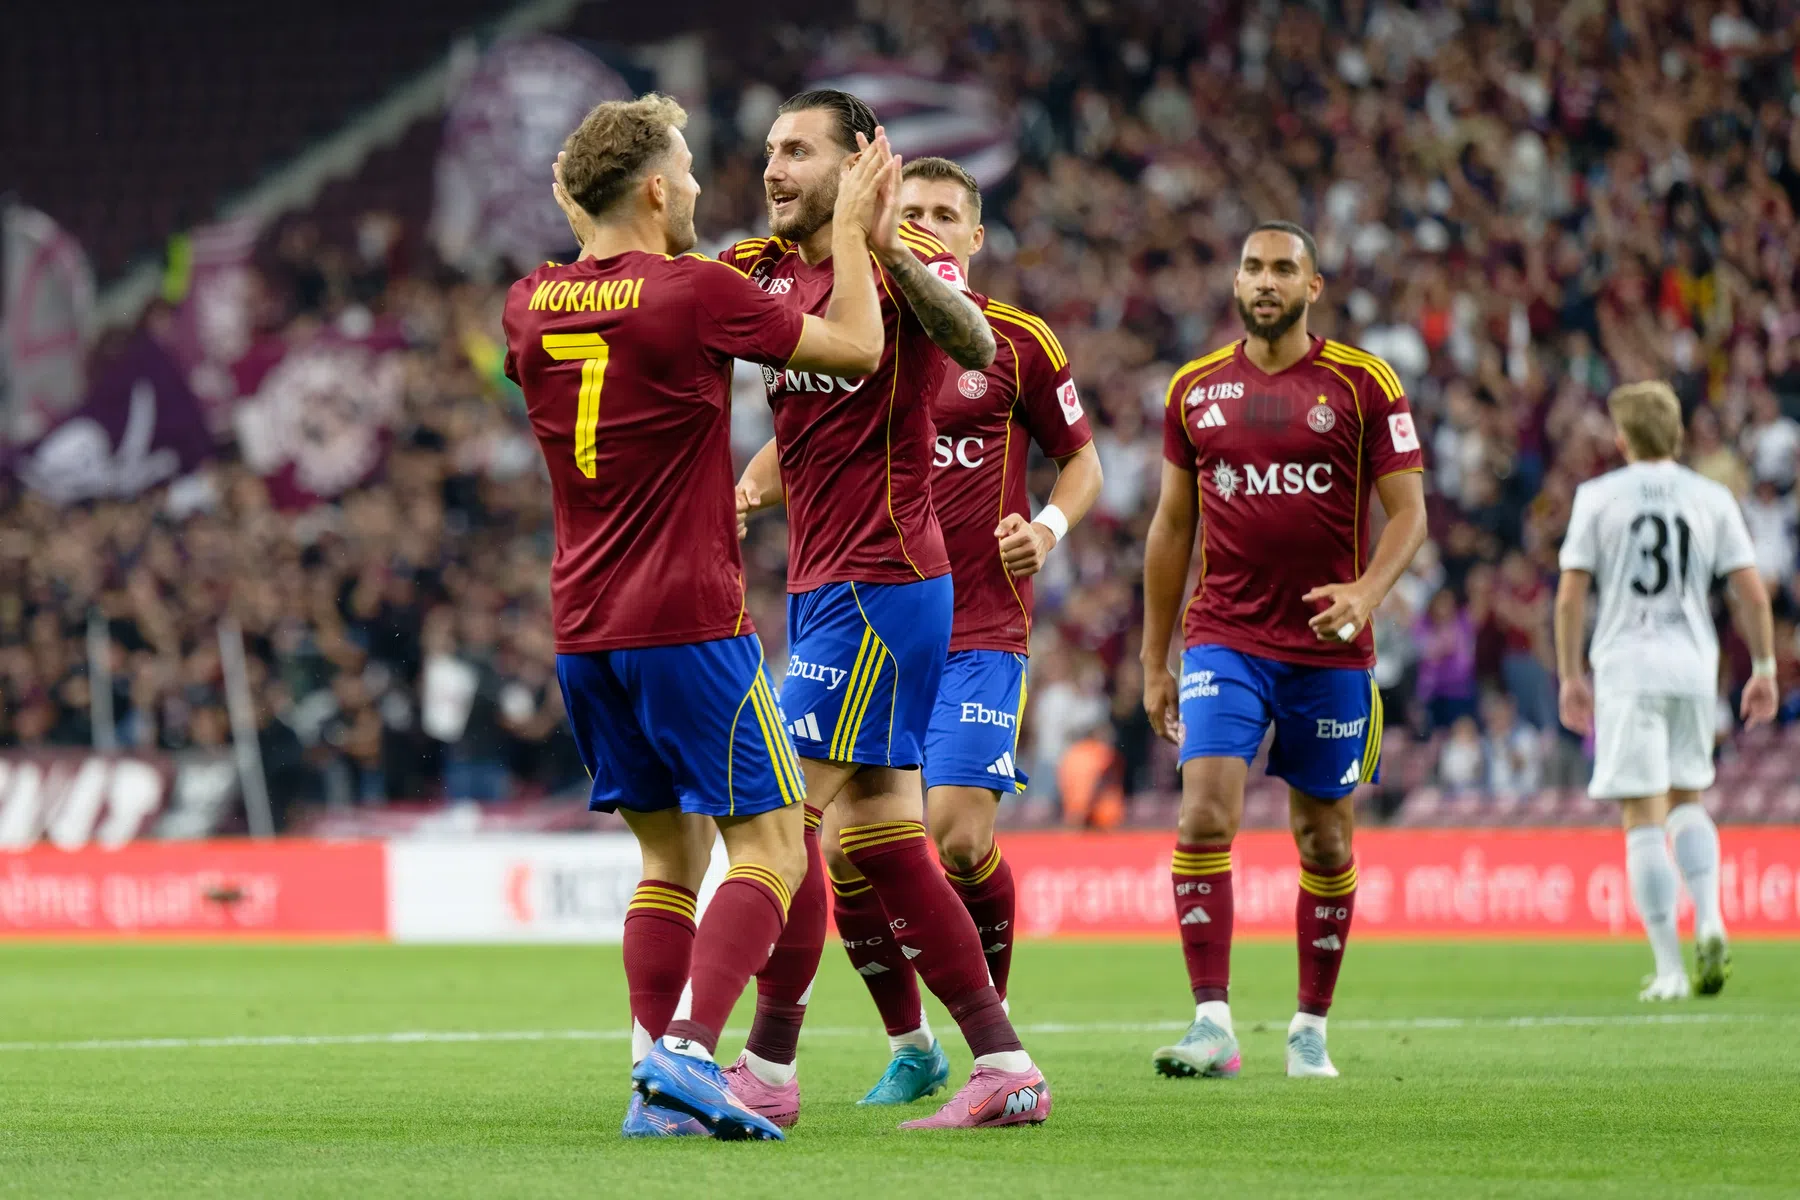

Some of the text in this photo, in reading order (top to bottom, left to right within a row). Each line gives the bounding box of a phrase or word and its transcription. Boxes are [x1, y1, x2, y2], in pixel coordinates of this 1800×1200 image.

[528, 277, 645, 312] MORANDI
[541, 332, 610, 479] 7
[1207, 382, 1245, 400] UBS
[932, 435, 984, 468] SC
[1242, 462, 1333, 495] MSC
[1630, 511, 1690, 597] 31
[1404, 846, 1575, 922] même
[1314, 906, 1348, 921] SFC
